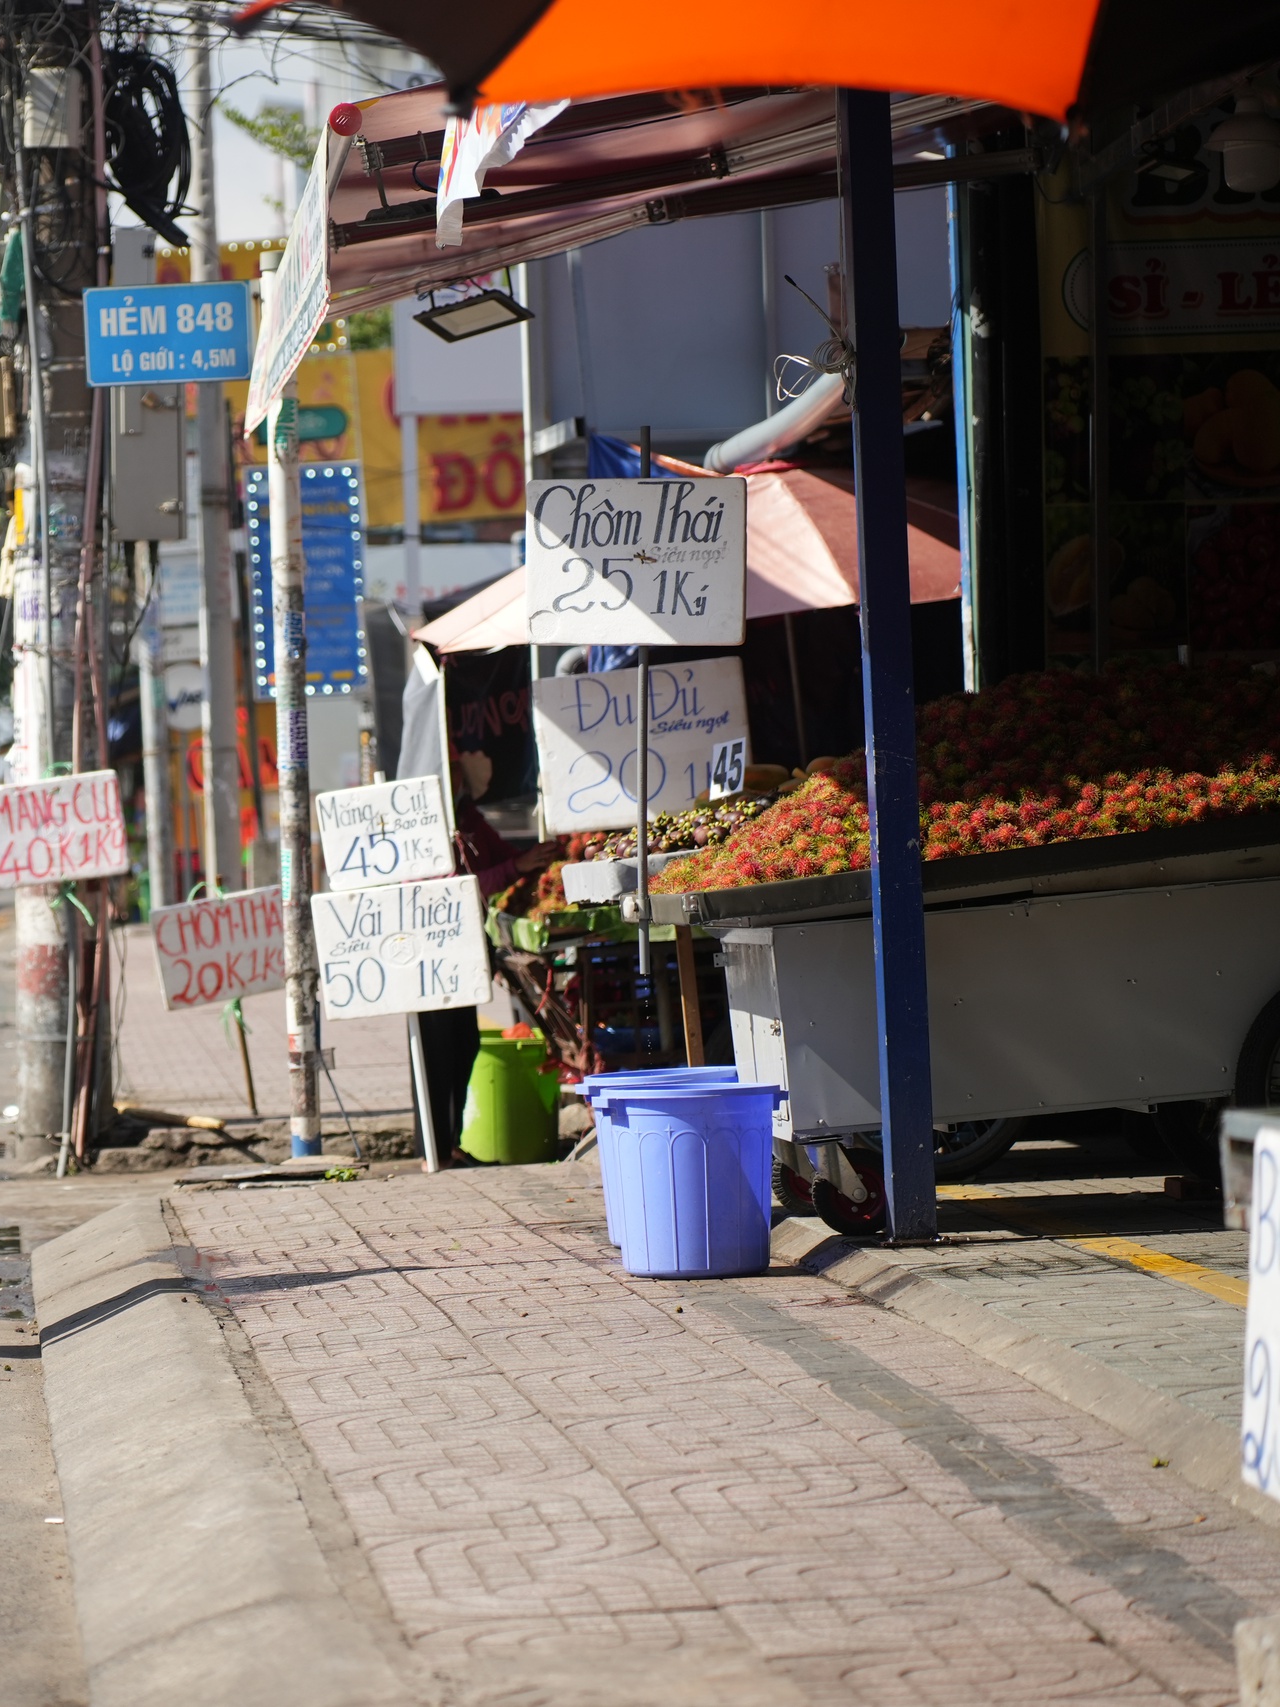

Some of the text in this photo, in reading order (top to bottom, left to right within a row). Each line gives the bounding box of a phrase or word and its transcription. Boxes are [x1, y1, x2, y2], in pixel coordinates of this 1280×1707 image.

[99, 295, 234, 338] HẺM 848
[112, 348, 134, 377] LỘ
[139, 345, 175, 371] GIỚI
[191, 348, 236, 370] 4,5M
[533, 481, 725, 550] Chôm Thái
[552, 556, 635, 613] 25
[560, 677, 638, 733] Đu
[647, 668, 706, 721] Đủ
[567, 746, 667, 814] 20
[712, 741, 744, 793] 45
[318, 780, 429, 832] Măng Cụt
[393, 811, 438, 831] Bao ăn
[340, 830, 400, 878] 45
[327, 885, 464, 939] Vải Thiều
[425, 921, 463, 948] ngọt
[324, 956, 386, 1008] 50
